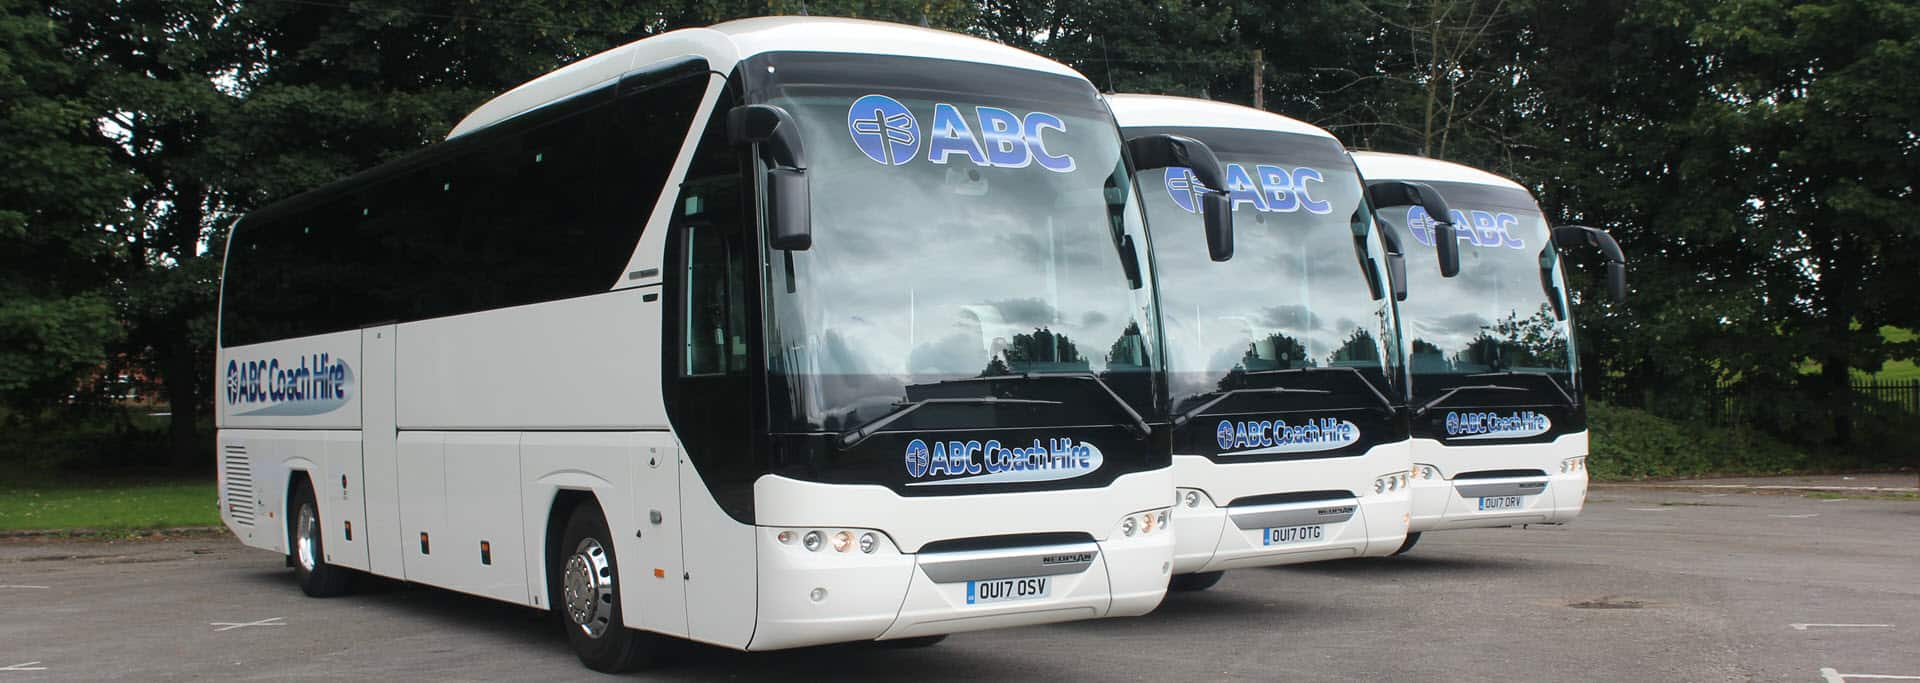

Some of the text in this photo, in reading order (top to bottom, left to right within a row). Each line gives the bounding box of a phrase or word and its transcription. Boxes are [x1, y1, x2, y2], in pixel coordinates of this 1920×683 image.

[928, 103, 1077, 173] ABC
[1226, 163, 1333, 214] ABC
[1449, 208, 1526, 249] ABC
[239, 352, 345, 403] ABC Coach Hire
[1234, 417, 1350, 448] ABC Coach Hire
[1459, 411, 1545, 434] ABC Coach Hire
[929, 437, 1090, 476] ABC Coach Hire
[1485, 497, 1504, 509] OU17
[1272, 525, 1321, 542] OU17 OTG
[980, 578, 1046, 600] OU17 OSV
